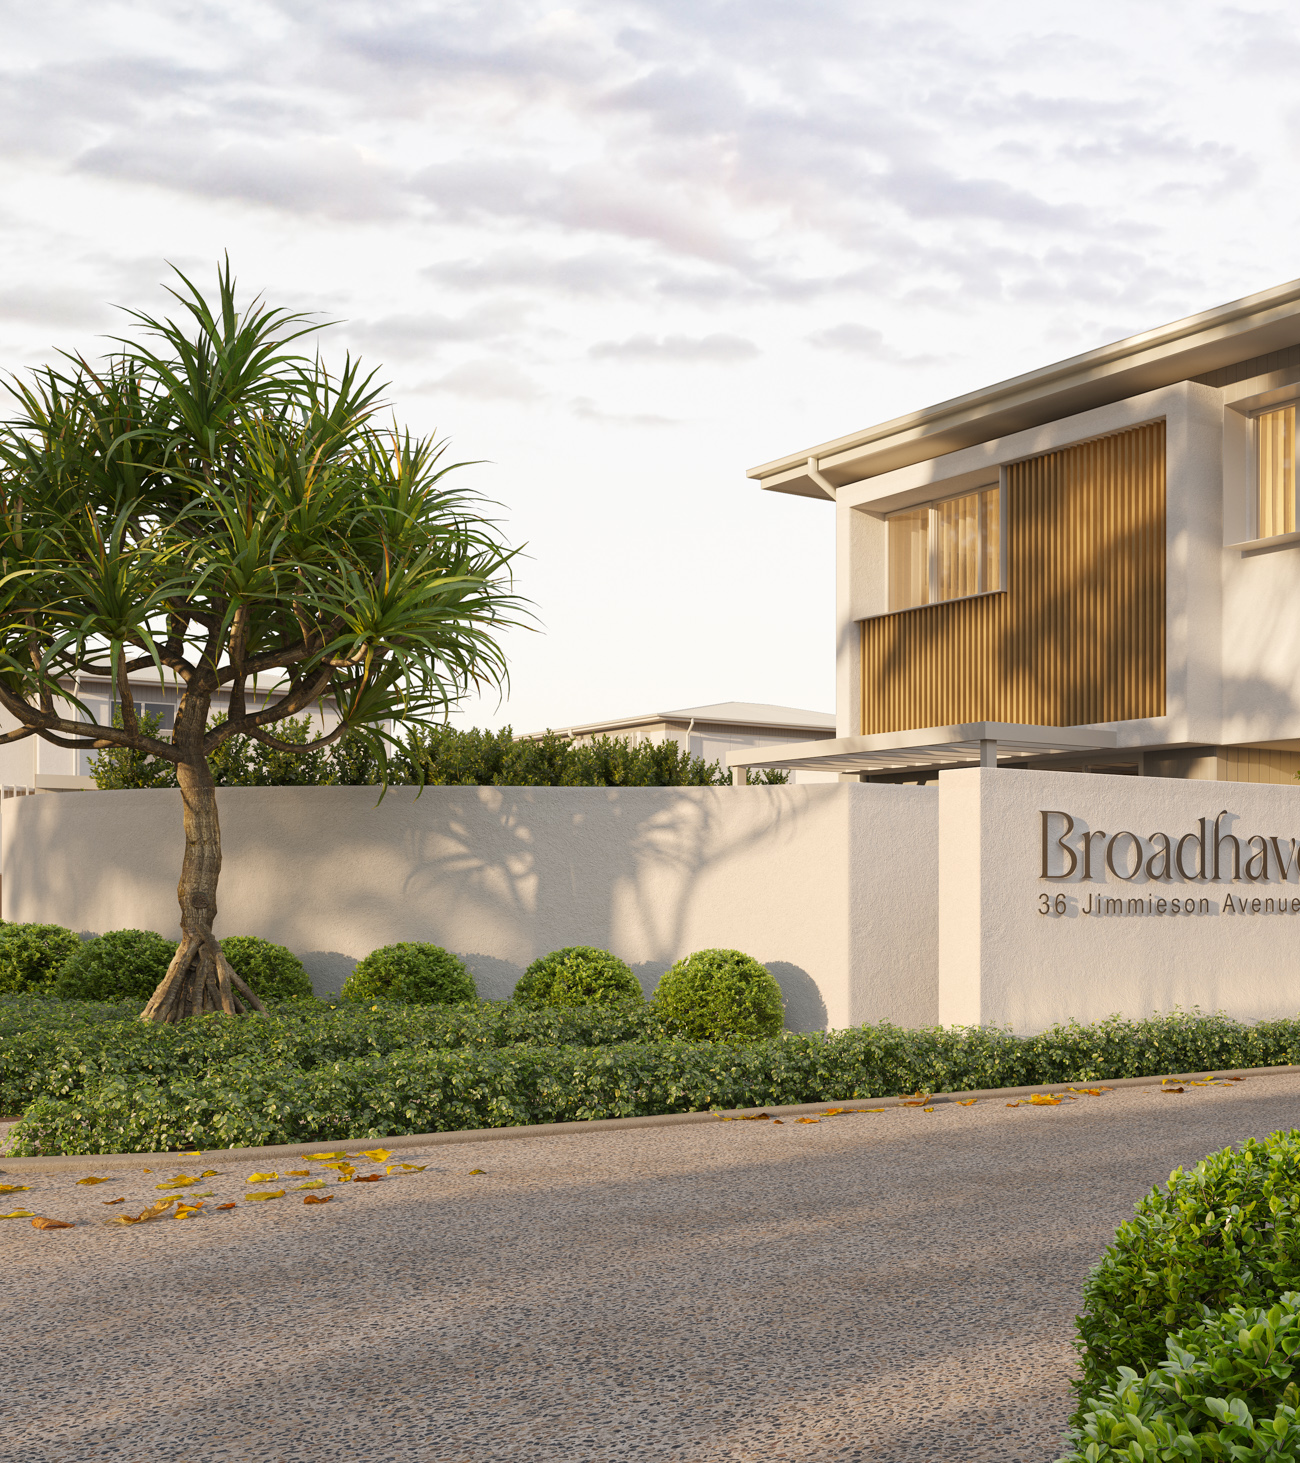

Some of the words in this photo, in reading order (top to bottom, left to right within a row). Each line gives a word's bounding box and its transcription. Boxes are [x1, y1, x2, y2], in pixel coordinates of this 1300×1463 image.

[1038, 893, 1067, 915] 36
[1082, 893, 1209, 915] Jimmieson
[1222, 893, 1300, 914] Avenue
